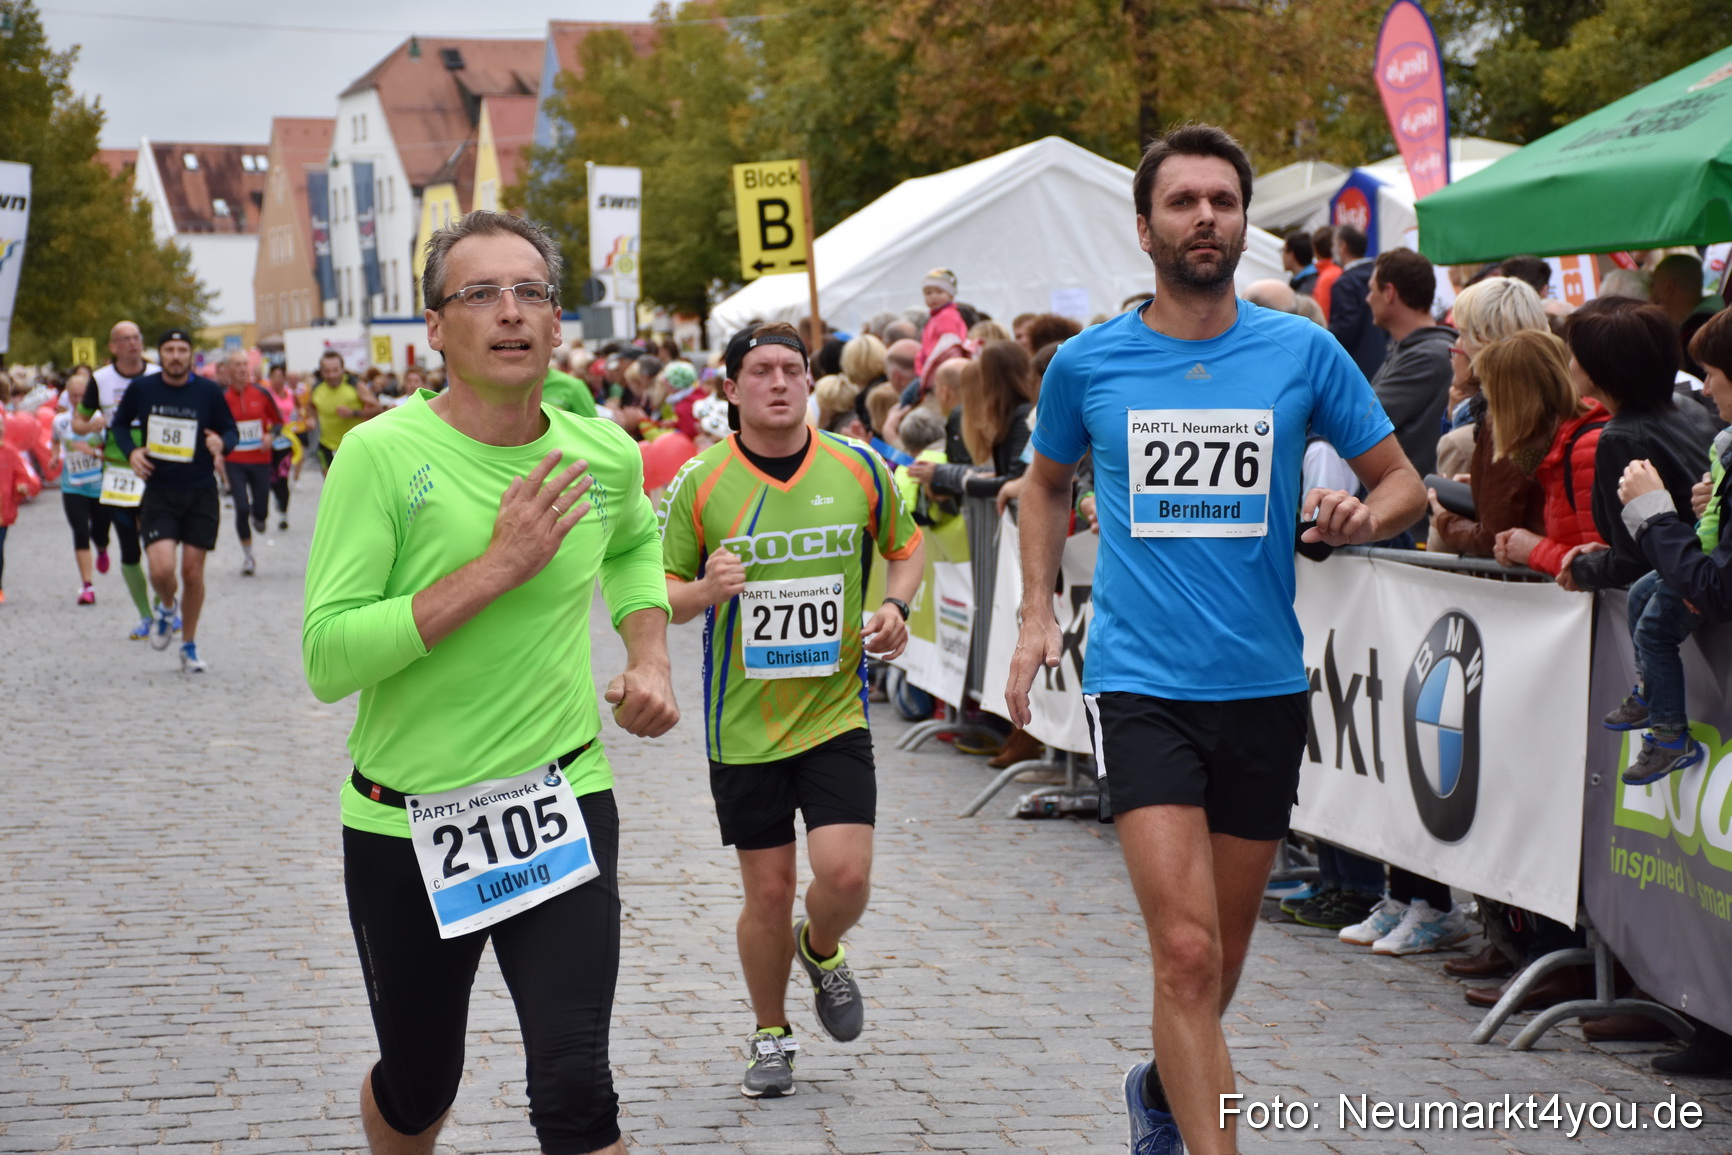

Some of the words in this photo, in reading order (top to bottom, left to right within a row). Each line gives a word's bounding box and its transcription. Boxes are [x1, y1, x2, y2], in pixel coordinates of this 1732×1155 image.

[743, 165, 801, 190] Block
[597, 194, 639, 210] swn
[757, 198, 794, 251] B
[161, 428, 181, 445] 58
[1132, 422, 1179, 434] PARTL
[1182, 422, 1249, 434] Neumarkt
[112, 476, 135, 492] 121
[1144, 440, 1260, 488] 2276
[1159, 500, 1241, 519] Bernhard
[720, 524, 858, 567] BOCK
[742, 590, 776, 600] PARTL
[779, 587, 829, 599] Neumarkt
[752, 600, 838, 641] 2709
[766, 649, 829, 665] Christian
[1413, 616, 1483, 696] BMW
[412, 802, 466, 823] PARTL
[468, 782, 541, 810] Neumarkt
[432, 794, 568, 880] 2105
[476, 863, 551, 905] Ludwig
[1610, 836, 1685, 894] inspired
